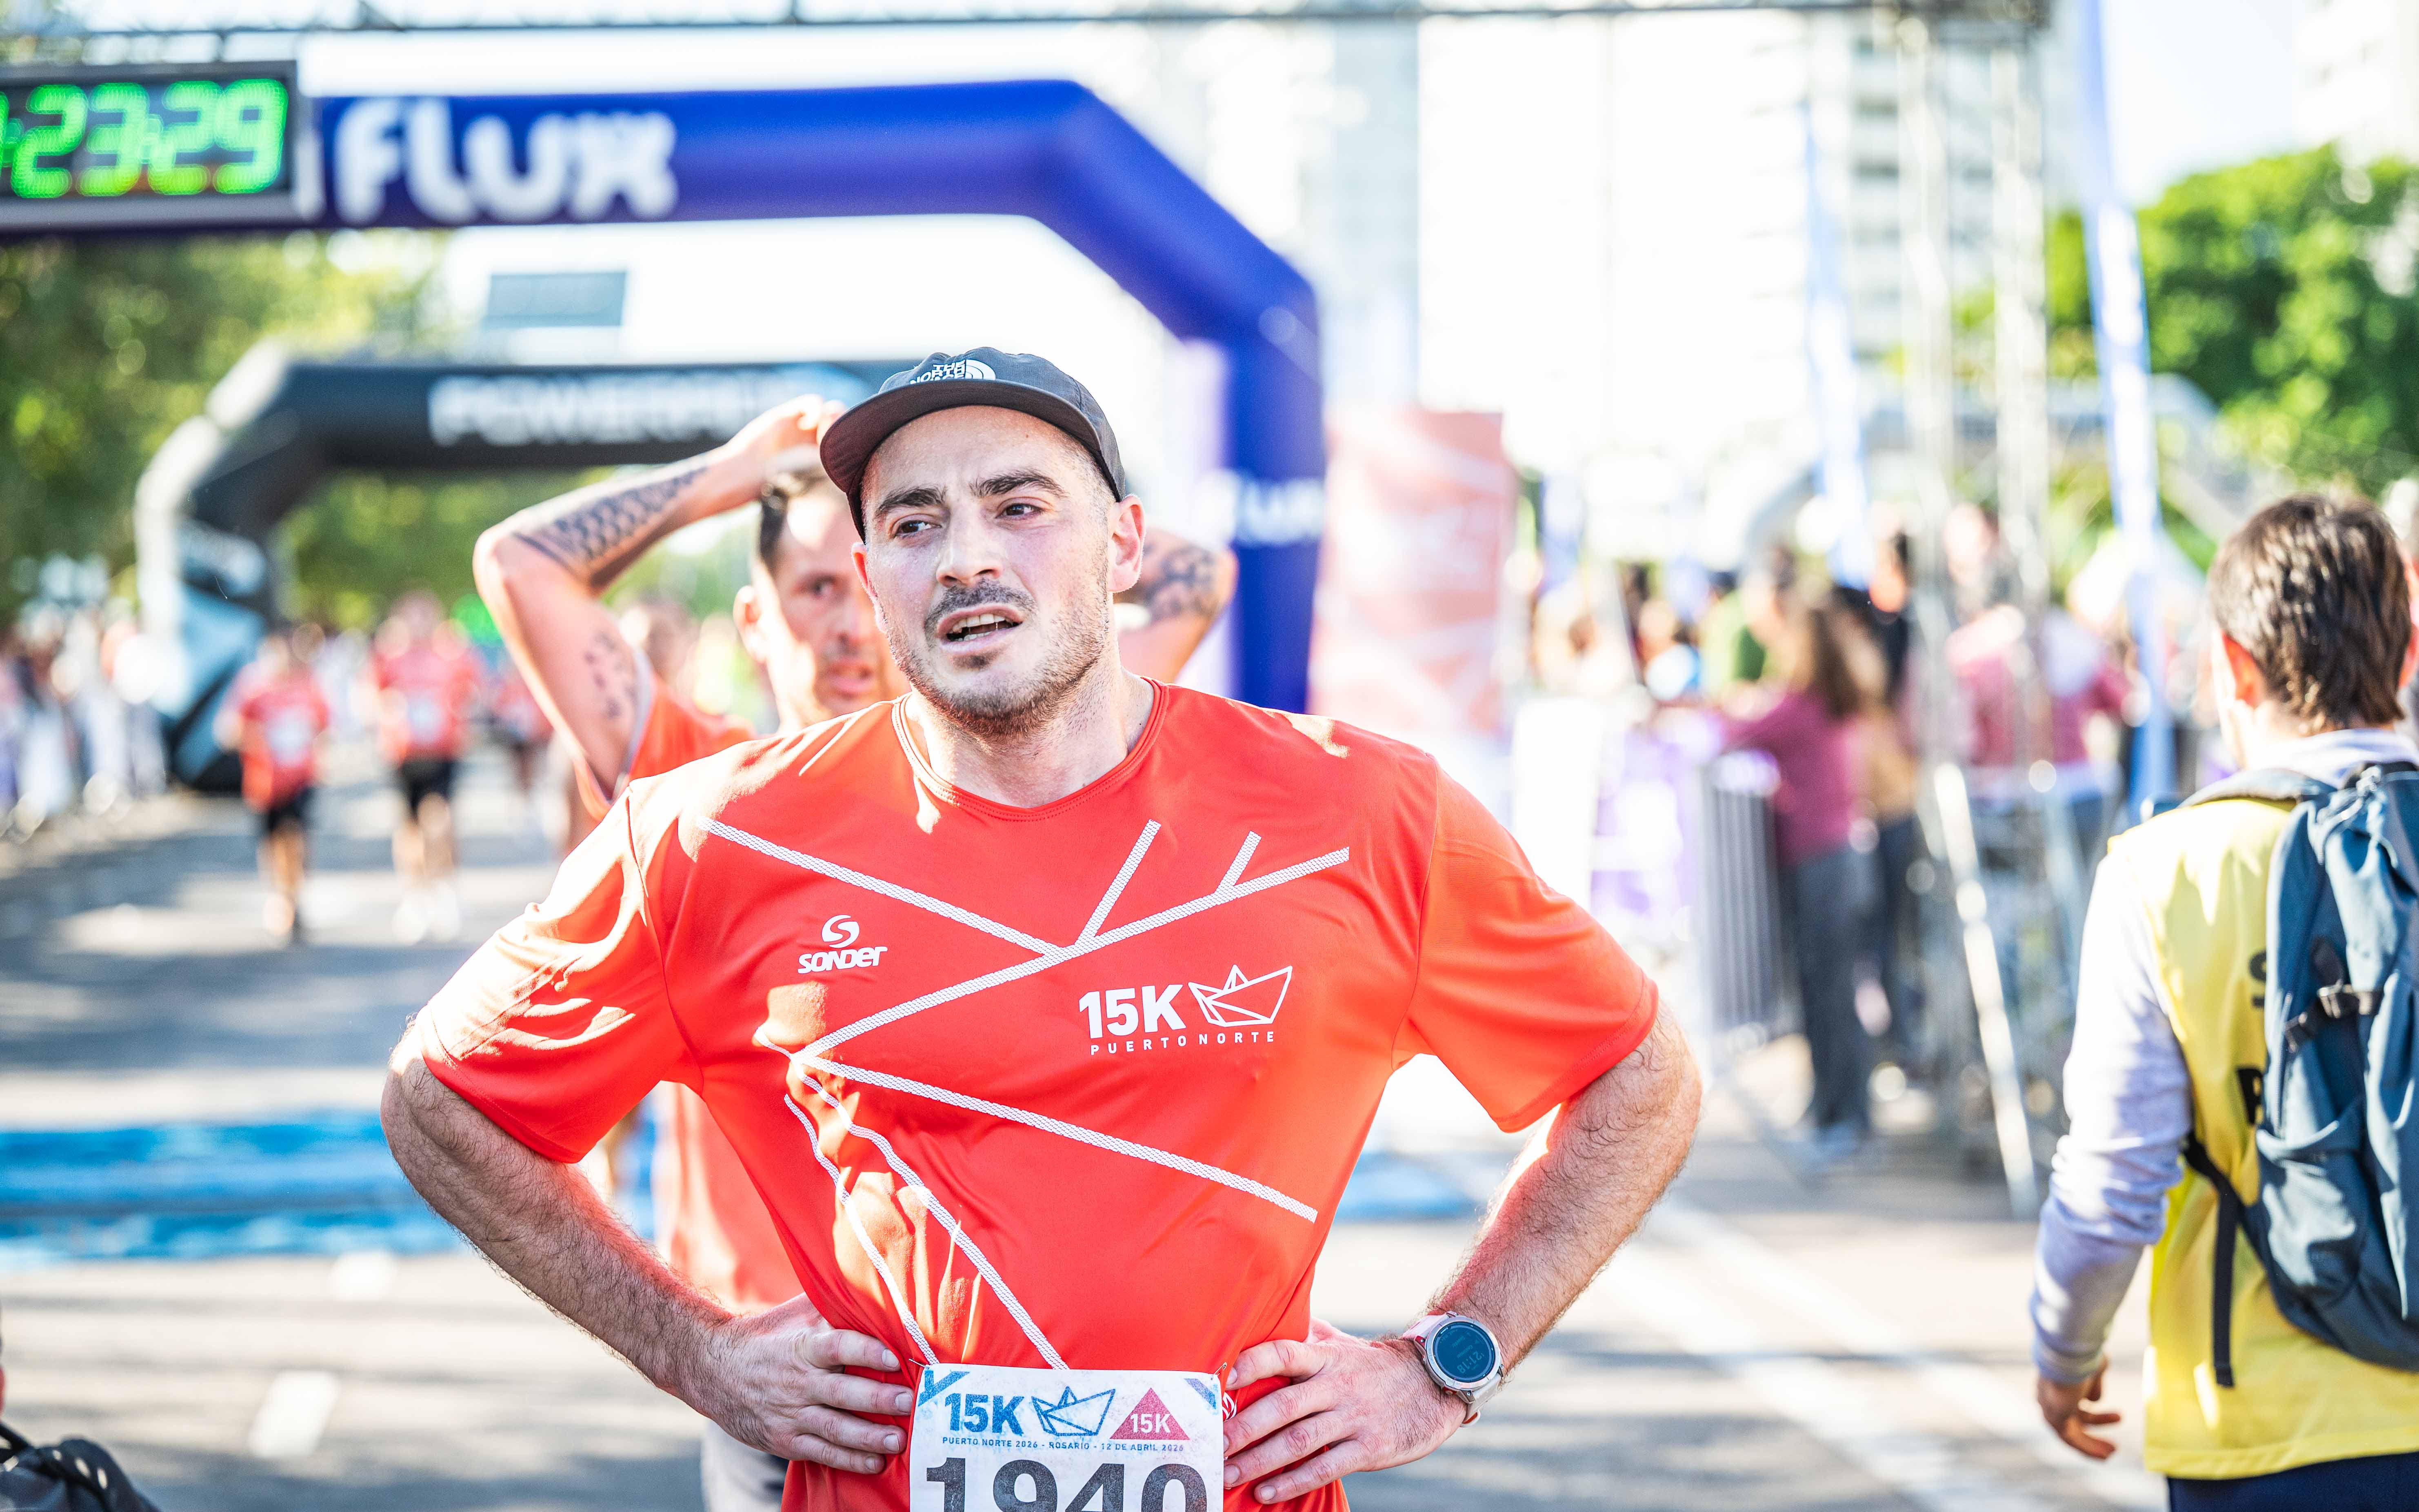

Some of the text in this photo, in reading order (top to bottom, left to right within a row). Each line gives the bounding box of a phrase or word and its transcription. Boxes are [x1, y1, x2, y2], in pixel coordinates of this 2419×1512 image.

[1079, 984, 1186, 1039] 15K
[1090, 1031, 1274, 1055] PUERTO NORTE
[944, 1393, 1025, 1434] 15K
[1130, 1413, 1171, 1434] 15K
[942, 1437, 978, 1445] PUERTO
[926, 1457, 1207, 1512] 1940
